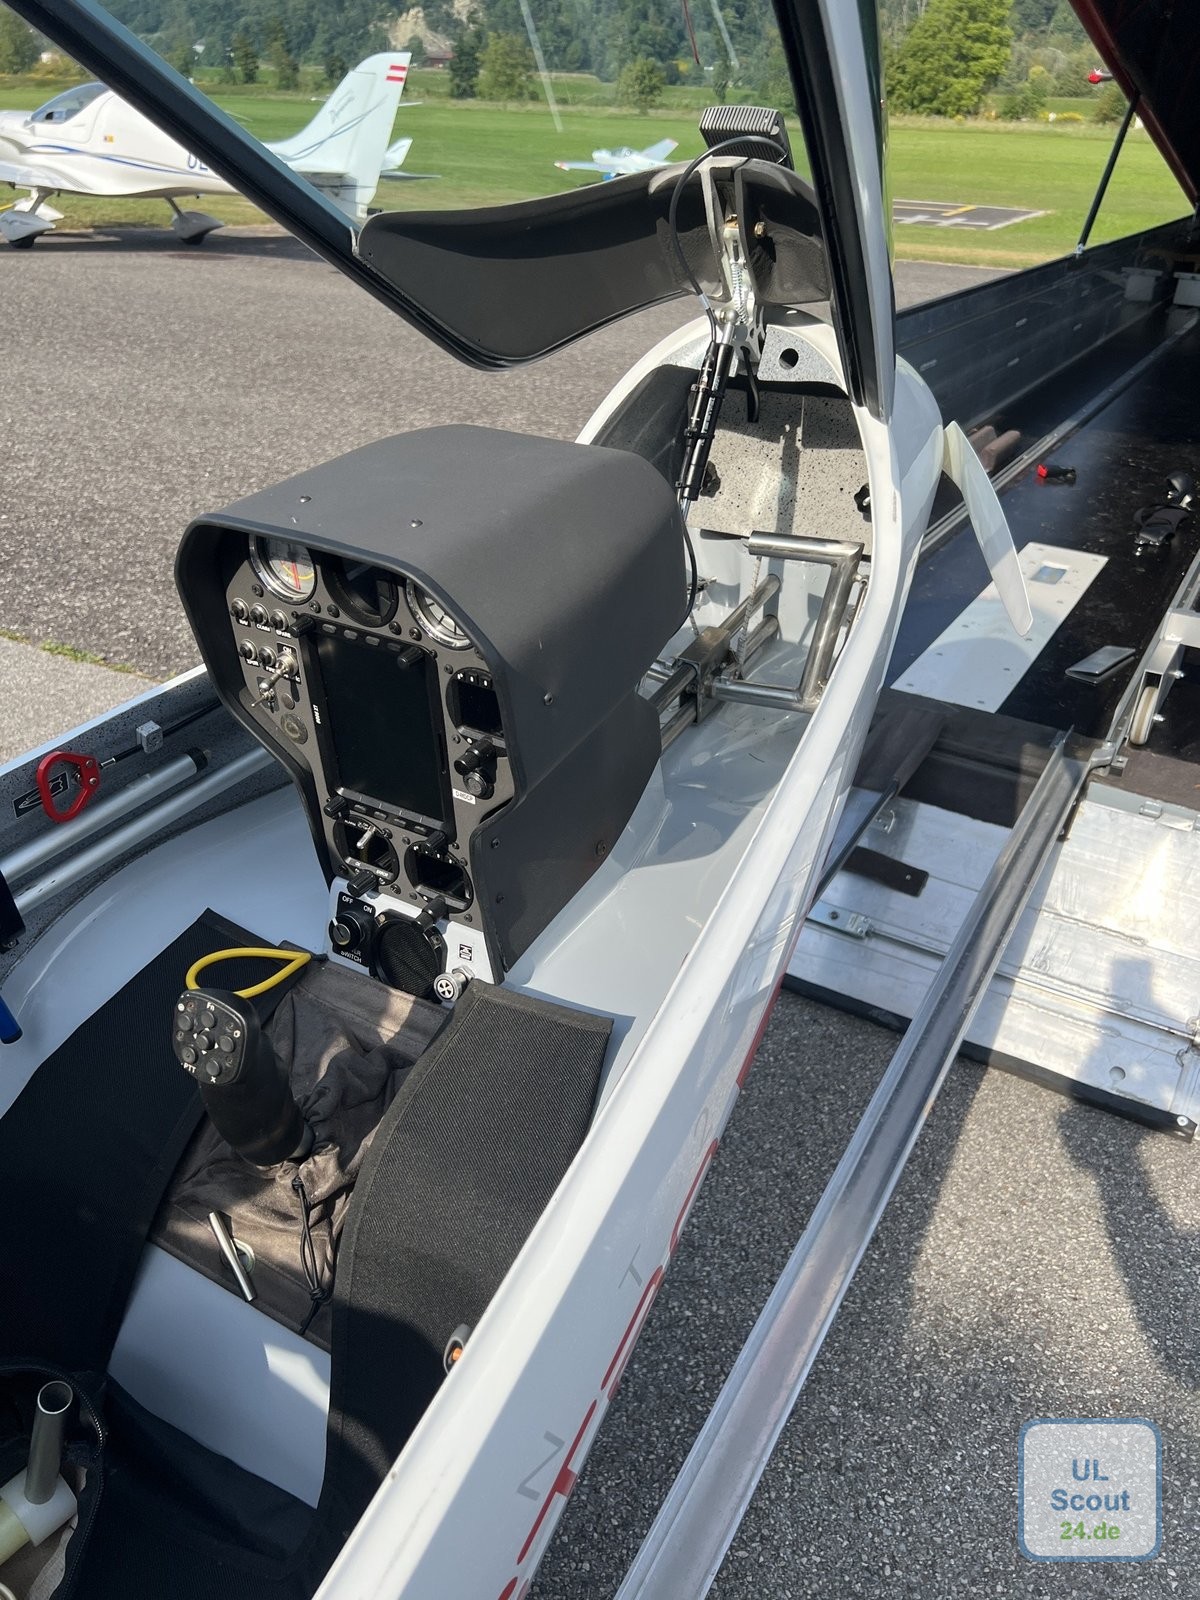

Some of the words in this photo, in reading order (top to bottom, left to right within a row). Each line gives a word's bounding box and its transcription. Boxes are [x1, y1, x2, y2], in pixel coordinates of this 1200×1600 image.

[341, 895, 354, 905] OFF
[363, 904, 373, 914] ON
[183, 1062, 196, 1074] PTT
